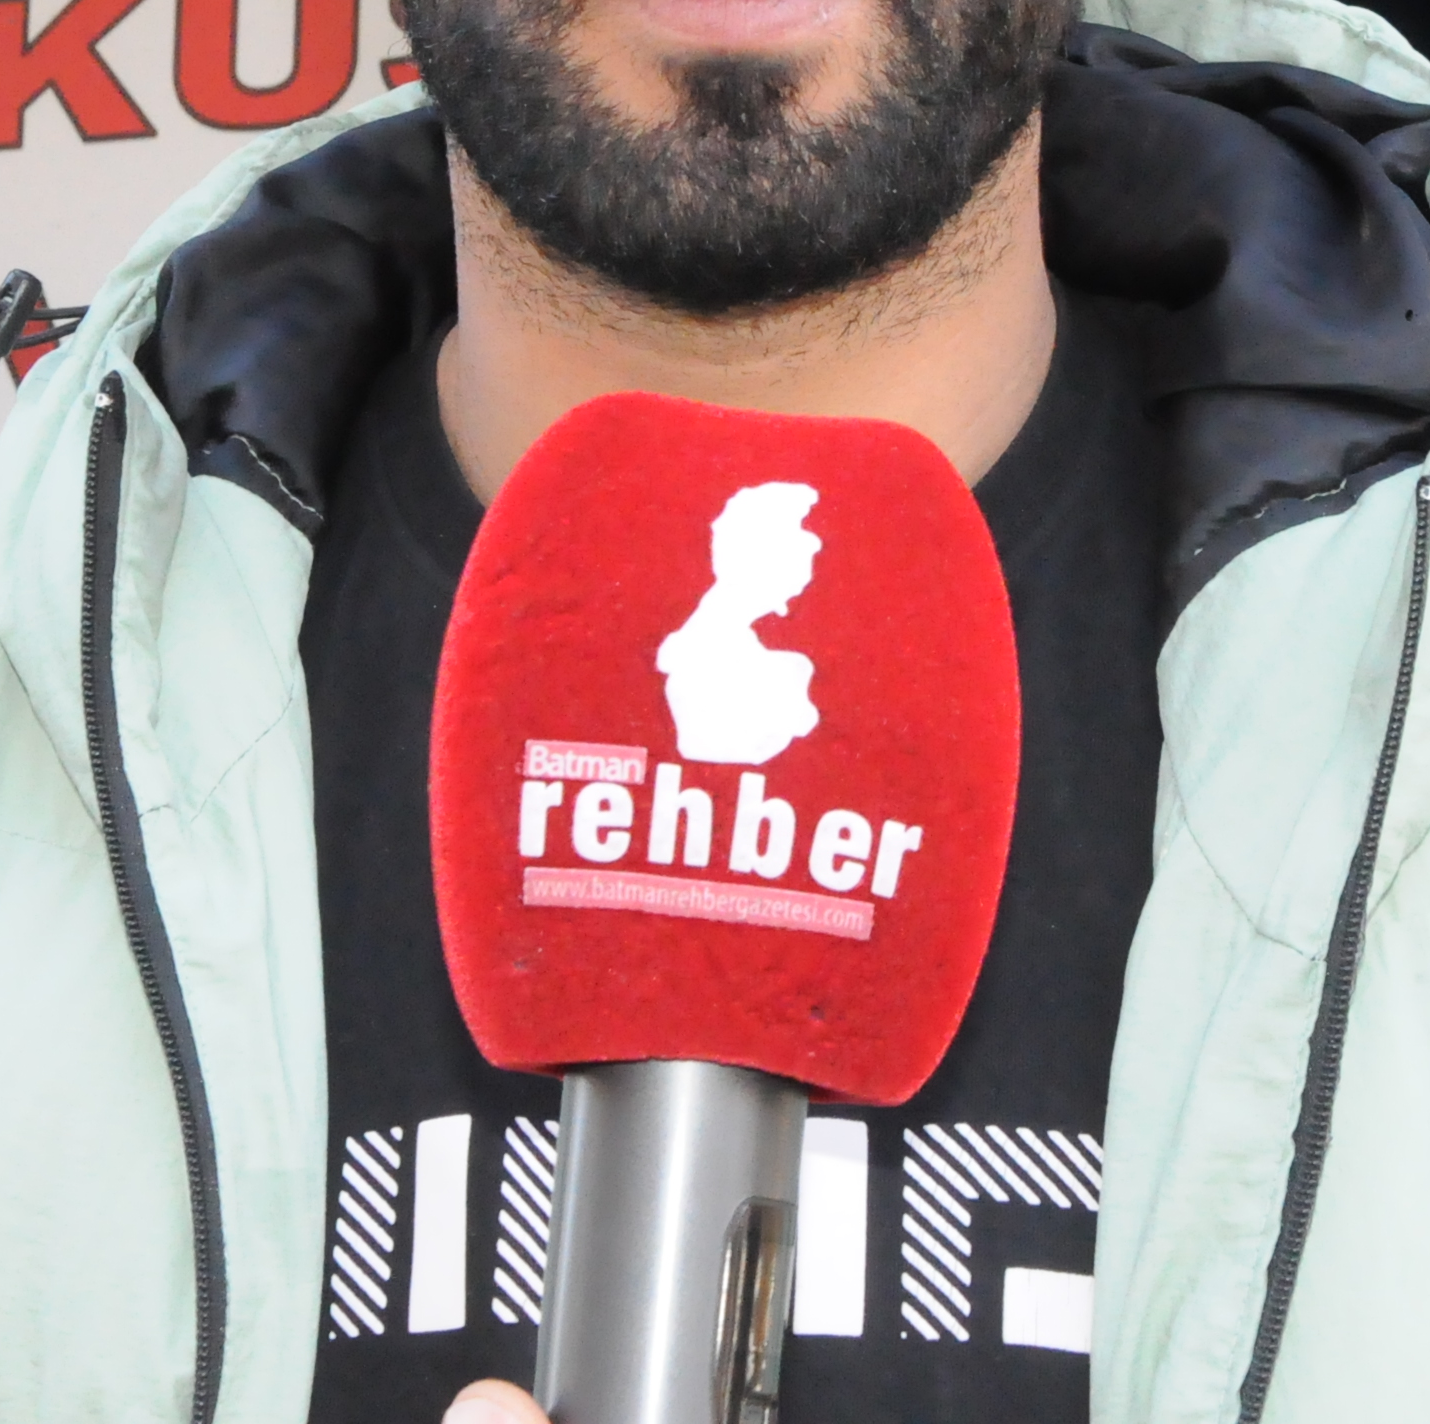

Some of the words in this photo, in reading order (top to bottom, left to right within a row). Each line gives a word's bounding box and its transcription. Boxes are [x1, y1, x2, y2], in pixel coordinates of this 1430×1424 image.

[528, 744, 644, 784] Batman
[518, 762, 923, 900] rehber
[530, 875, 866, 933] www.batmanrehbergazetesi.com
